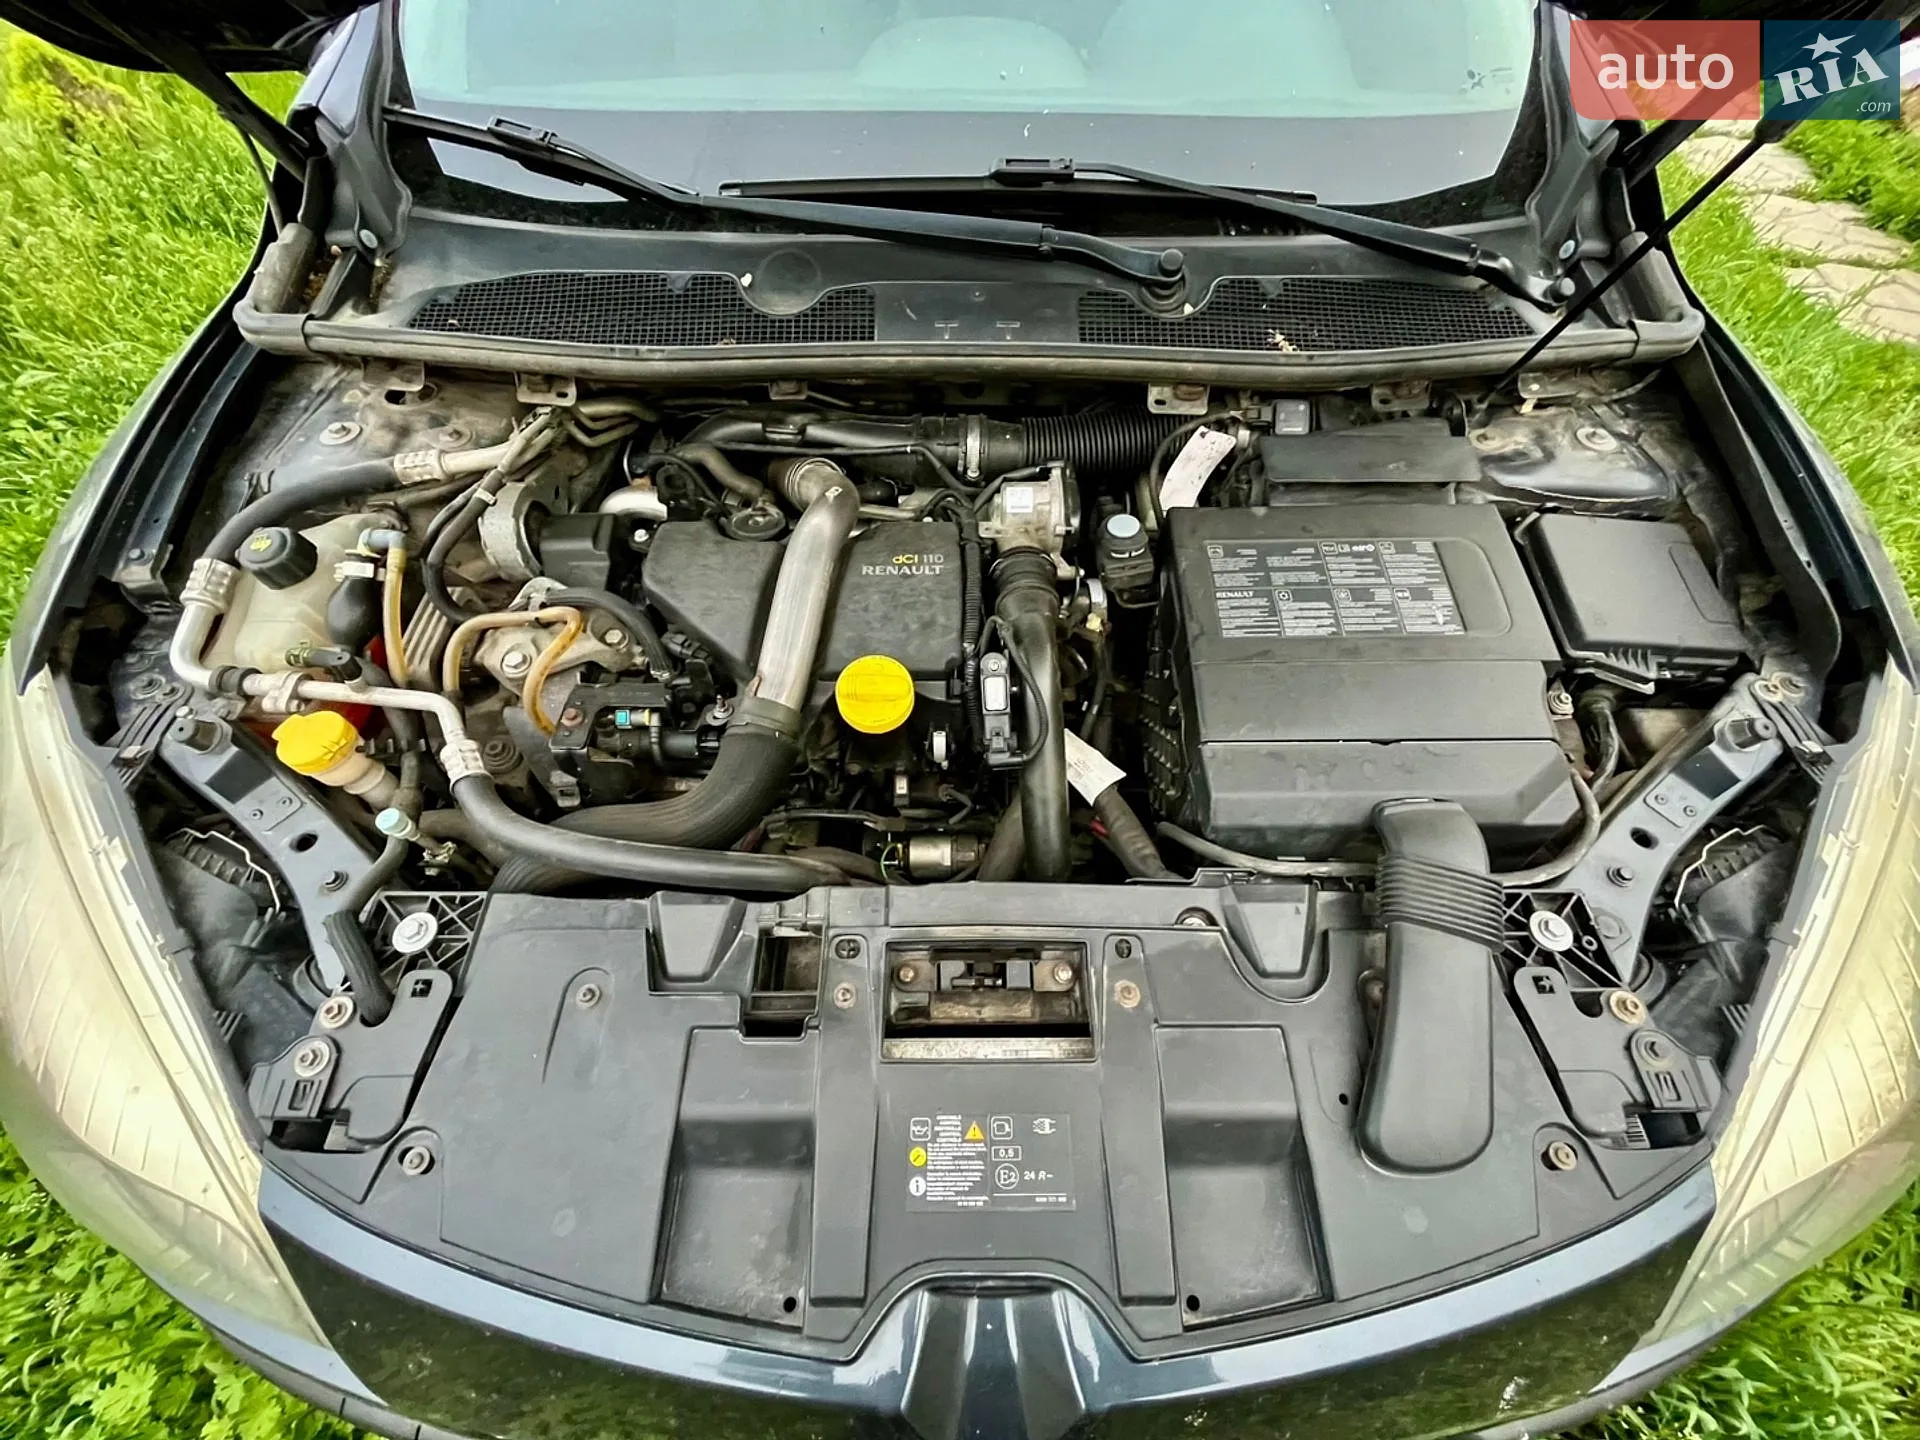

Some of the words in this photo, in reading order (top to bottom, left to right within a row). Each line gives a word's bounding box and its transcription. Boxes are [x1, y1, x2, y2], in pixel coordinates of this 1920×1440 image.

[923, 554, 944, 564] 110
[862, 565, 944, 576] RENAULT
[1023, 1170, 1036, 1180] 24
